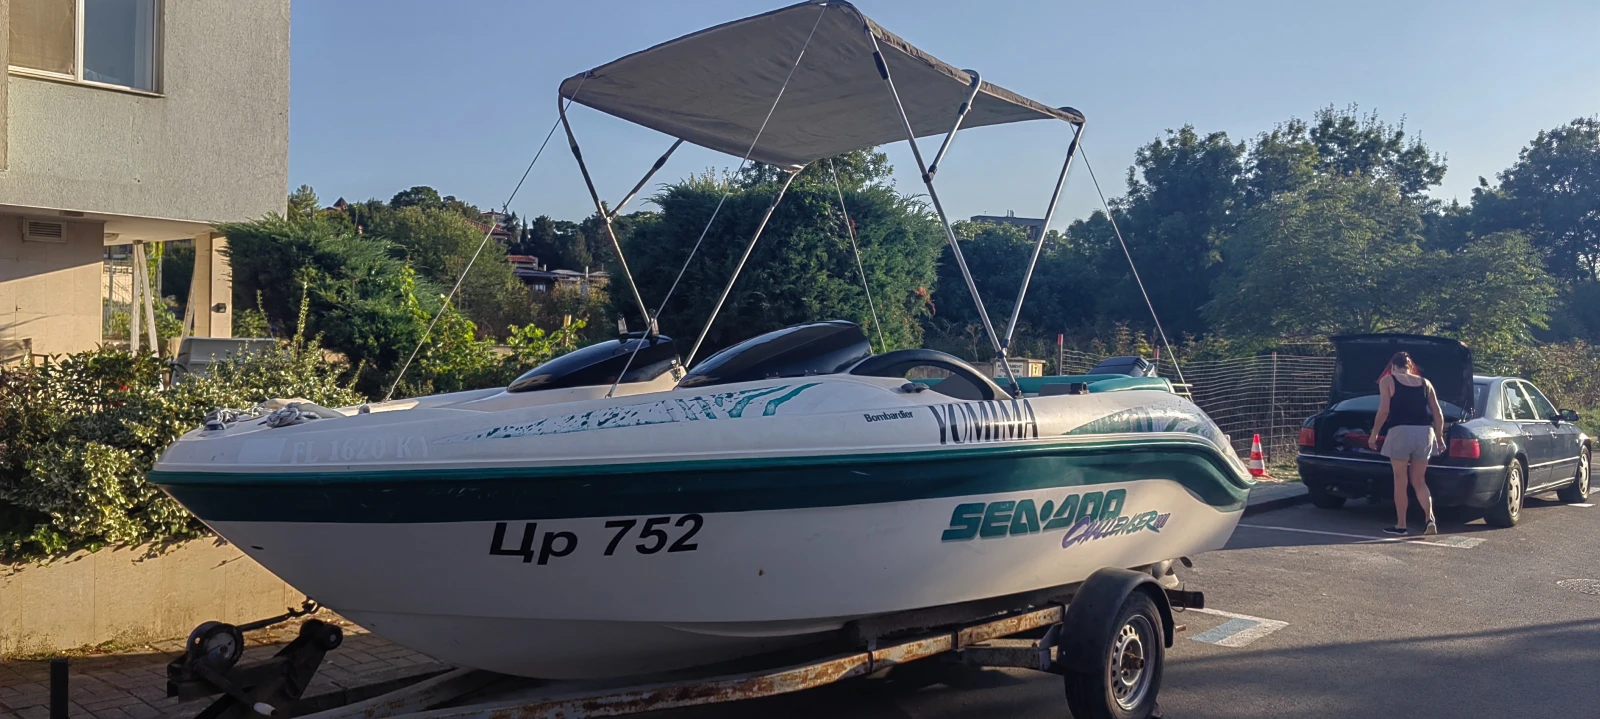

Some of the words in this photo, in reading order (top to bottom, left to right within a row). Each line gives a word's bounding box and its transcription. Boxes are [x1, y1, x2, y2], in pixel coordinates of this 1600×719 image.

[863, 410, 914, 423] Bombardier
[927, 399, 1039, 445] YOMIMA
[290, 440, 318, 465] FL
[329, 436, 387, 461] 1620
[489, 522, 578, 565] Цр
[603, 513, 704, 557] 752
